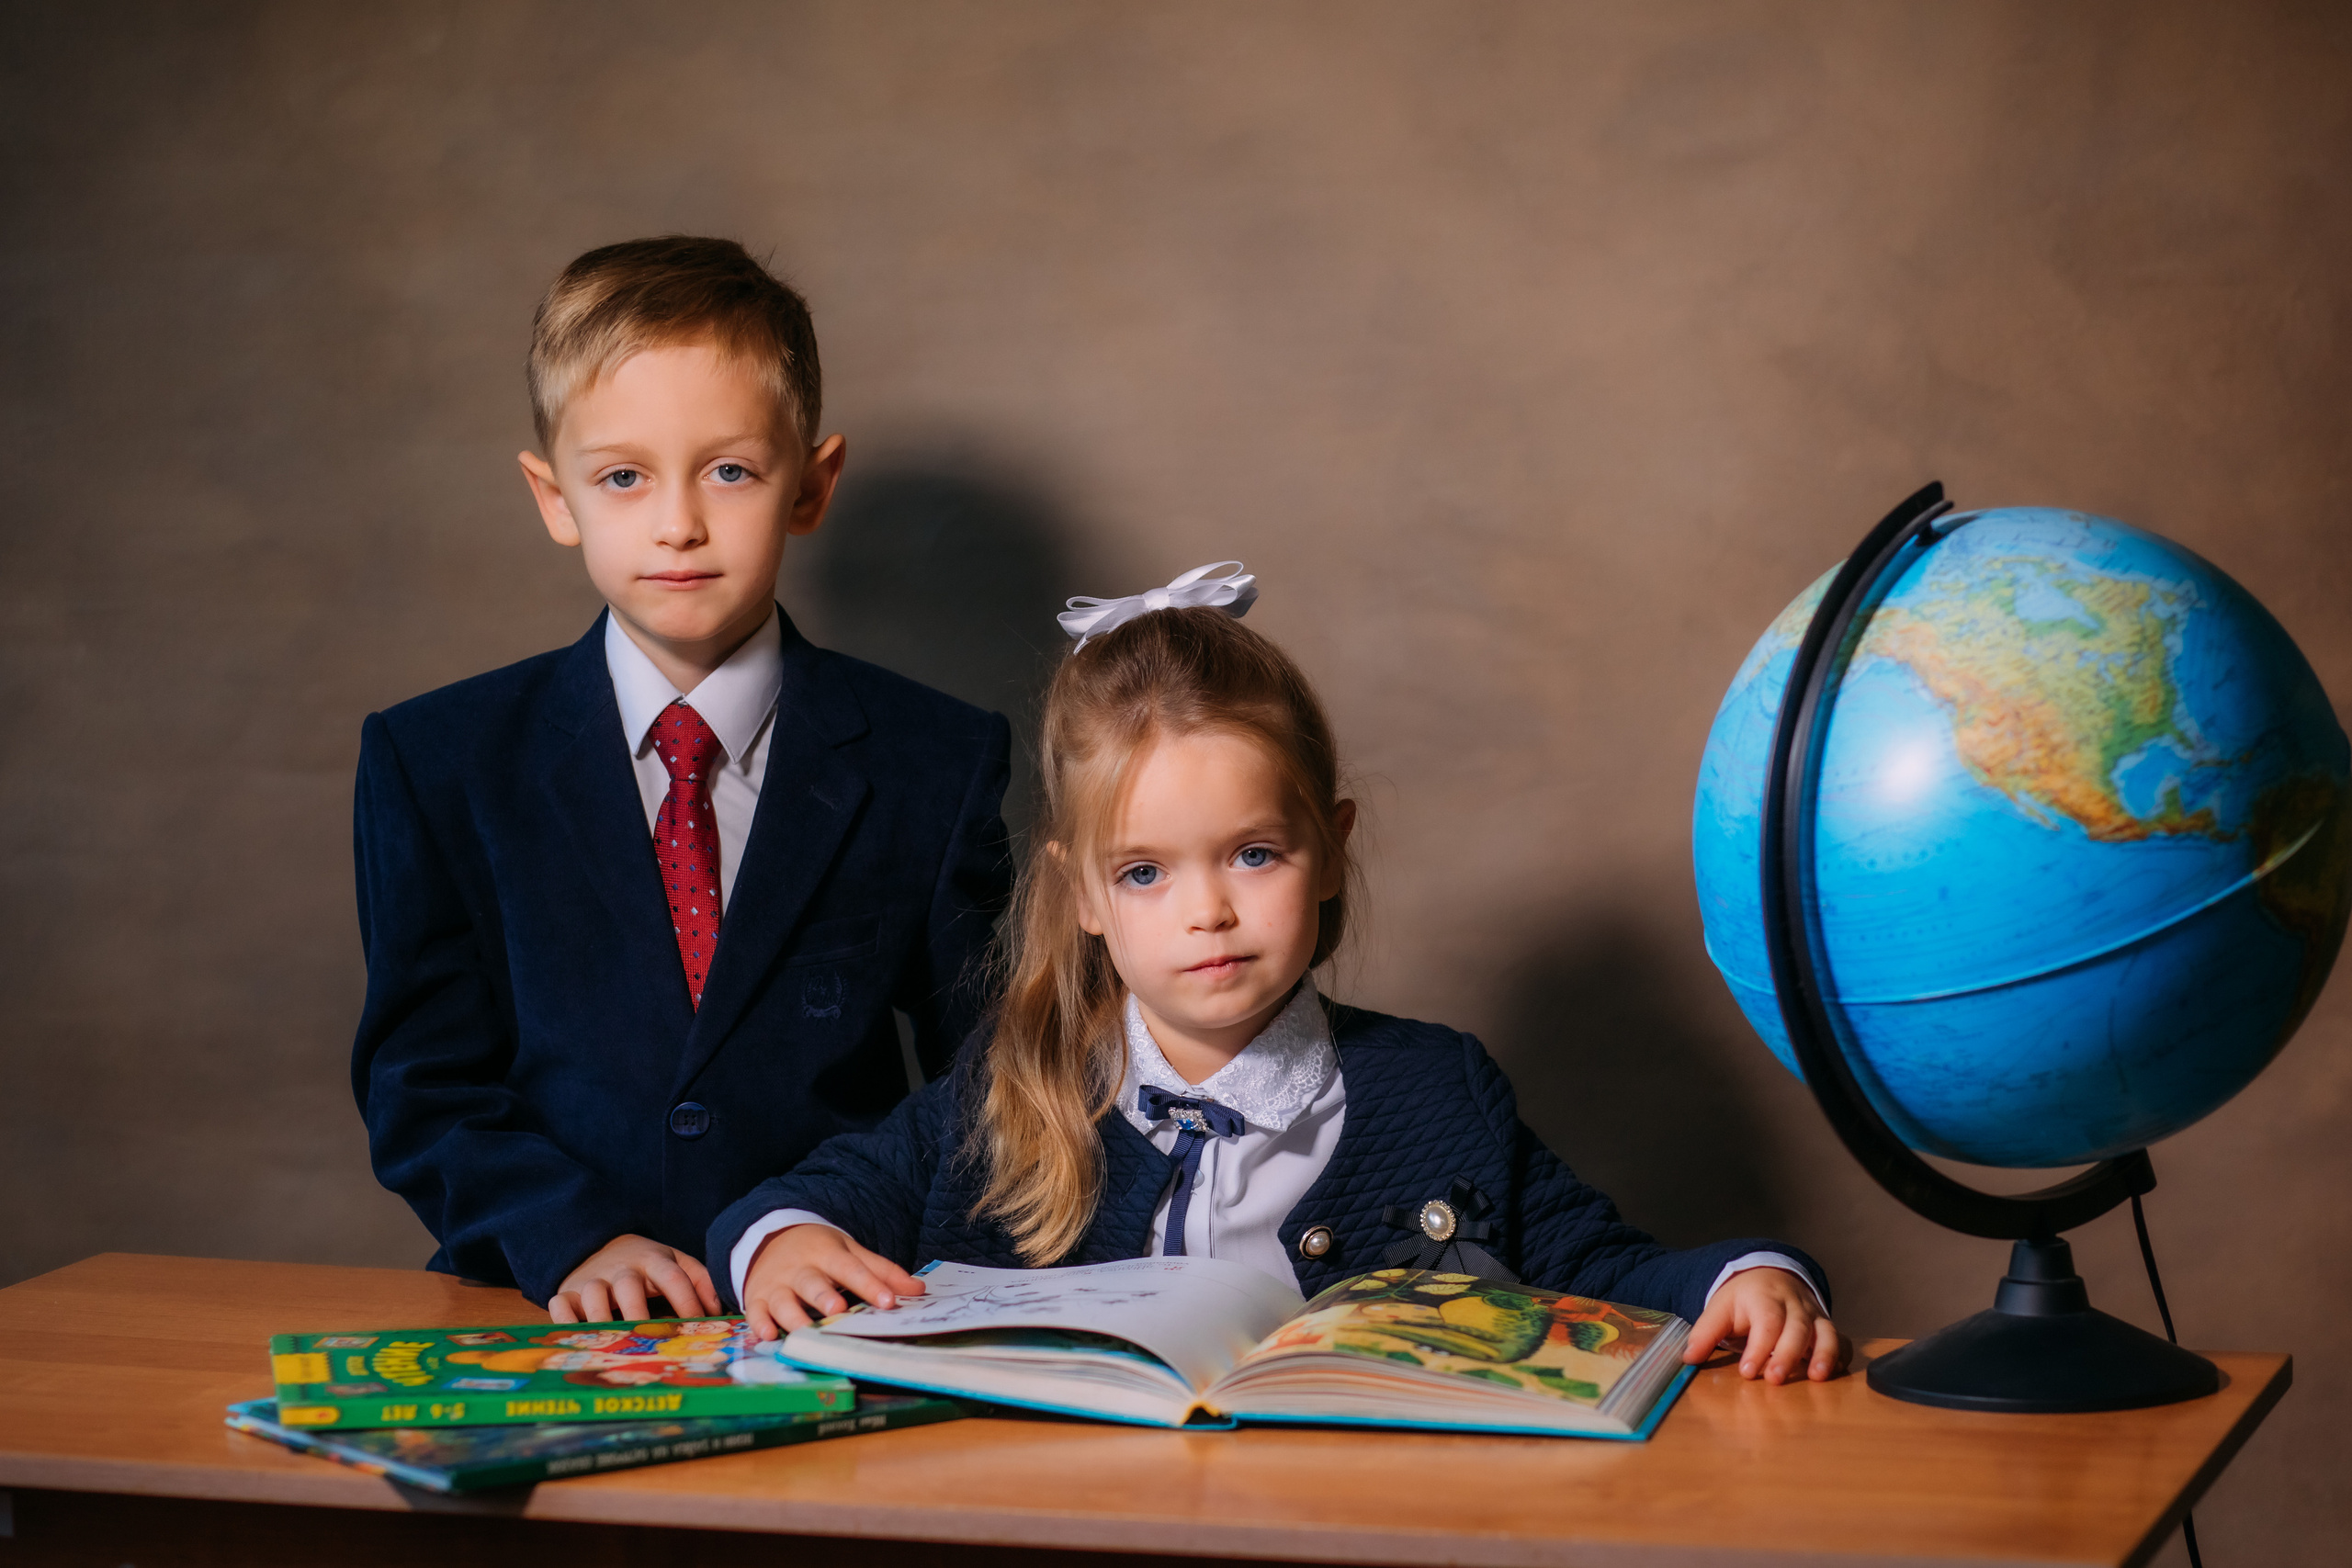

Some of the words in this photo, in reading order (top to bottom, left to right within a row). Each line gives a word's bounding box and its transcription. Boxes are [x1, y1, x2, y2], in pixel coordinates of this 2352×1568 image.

[506, 1399, 582, 1416] ЧТЕНИЕ
[594, 1393, 683, 1413] ДЕТСКОЕ
[381, 1404, 418, 1421] ЛЕТ
